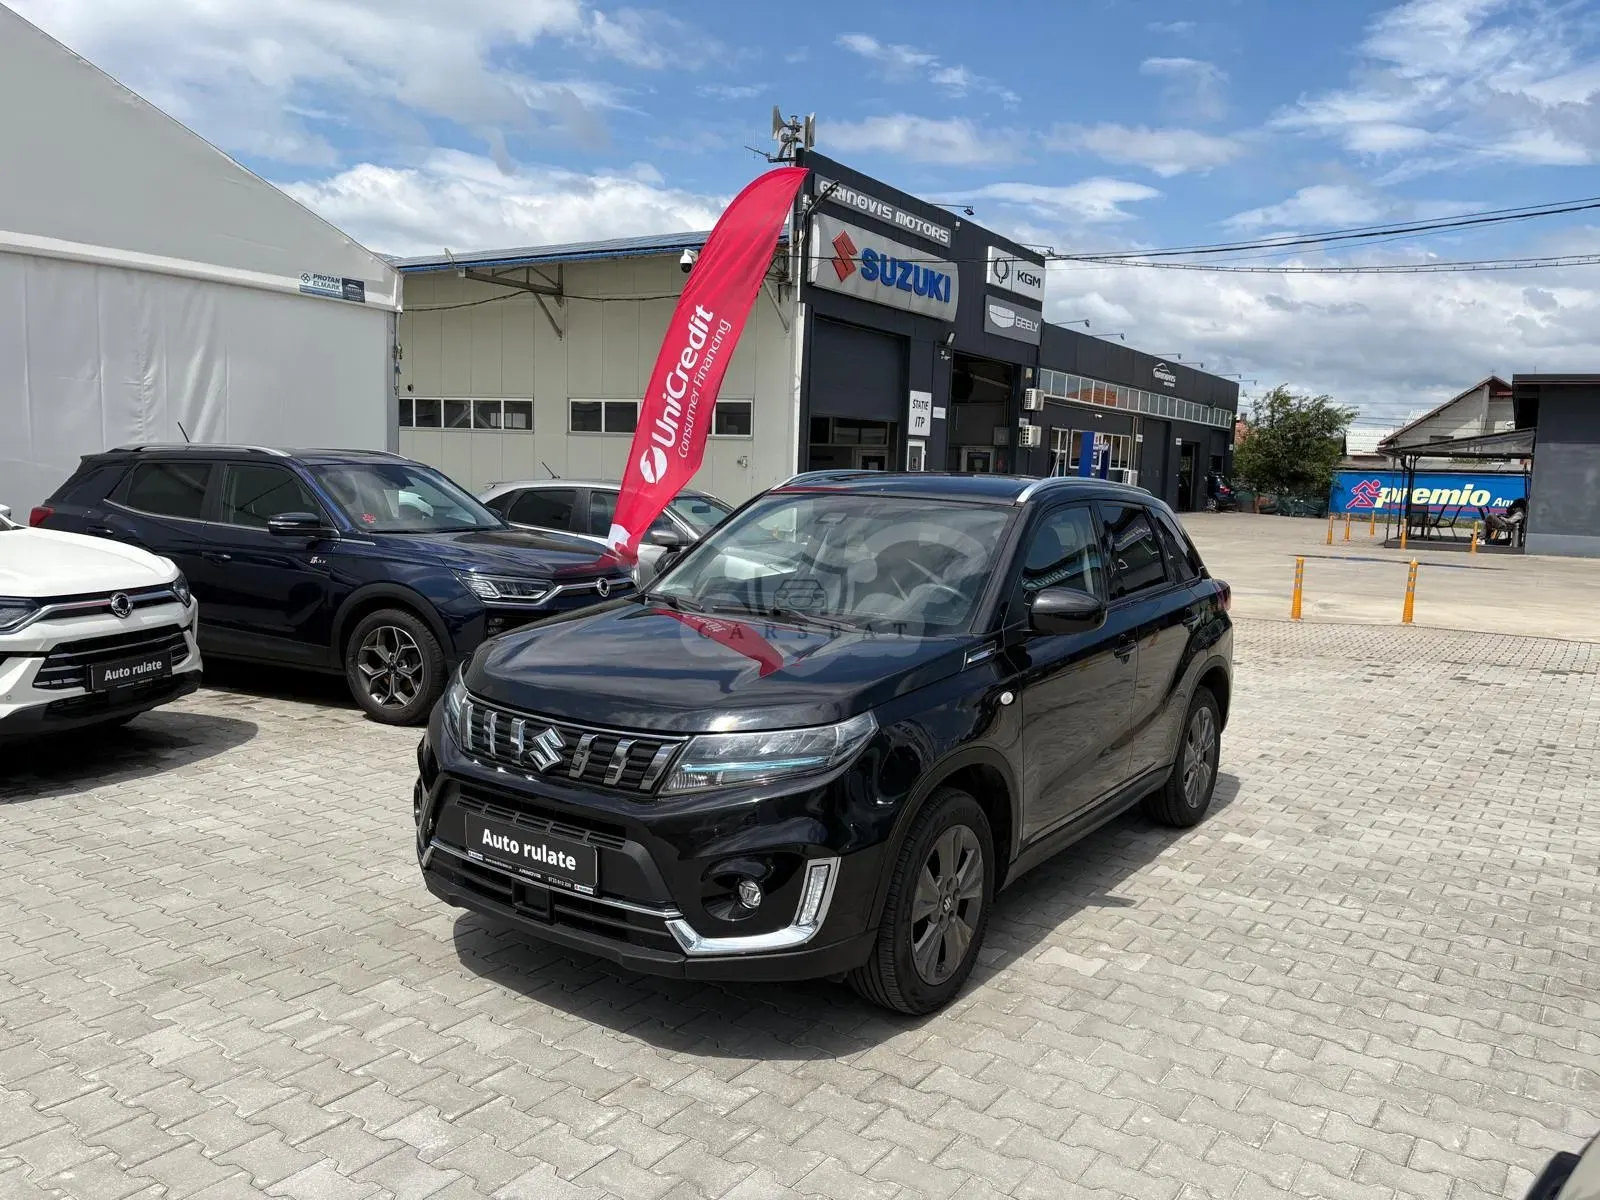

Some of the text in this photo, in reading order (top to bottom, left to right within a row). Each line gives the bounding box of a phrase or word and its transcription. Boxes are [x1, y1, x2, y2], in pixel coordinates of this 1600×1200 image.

[895, 211, 949, 243] MOTORS
[861, 247, 951, 303] SUZUKI
[1017, 270, 1041, 288] KGM
[1015, 316, 1039, 332] GEELY
[652, 304, 714, 448] UniCredit
[678, 318, 732, 458] Consumer Financing
[915, 416, 925, 428] ITP
[1374, 484, 1491, 508] premio
[104, 660, 162, 681] Auto rulate
[482, 828, 520, 854] Auto
[523, 843, 577, 871] rulate
